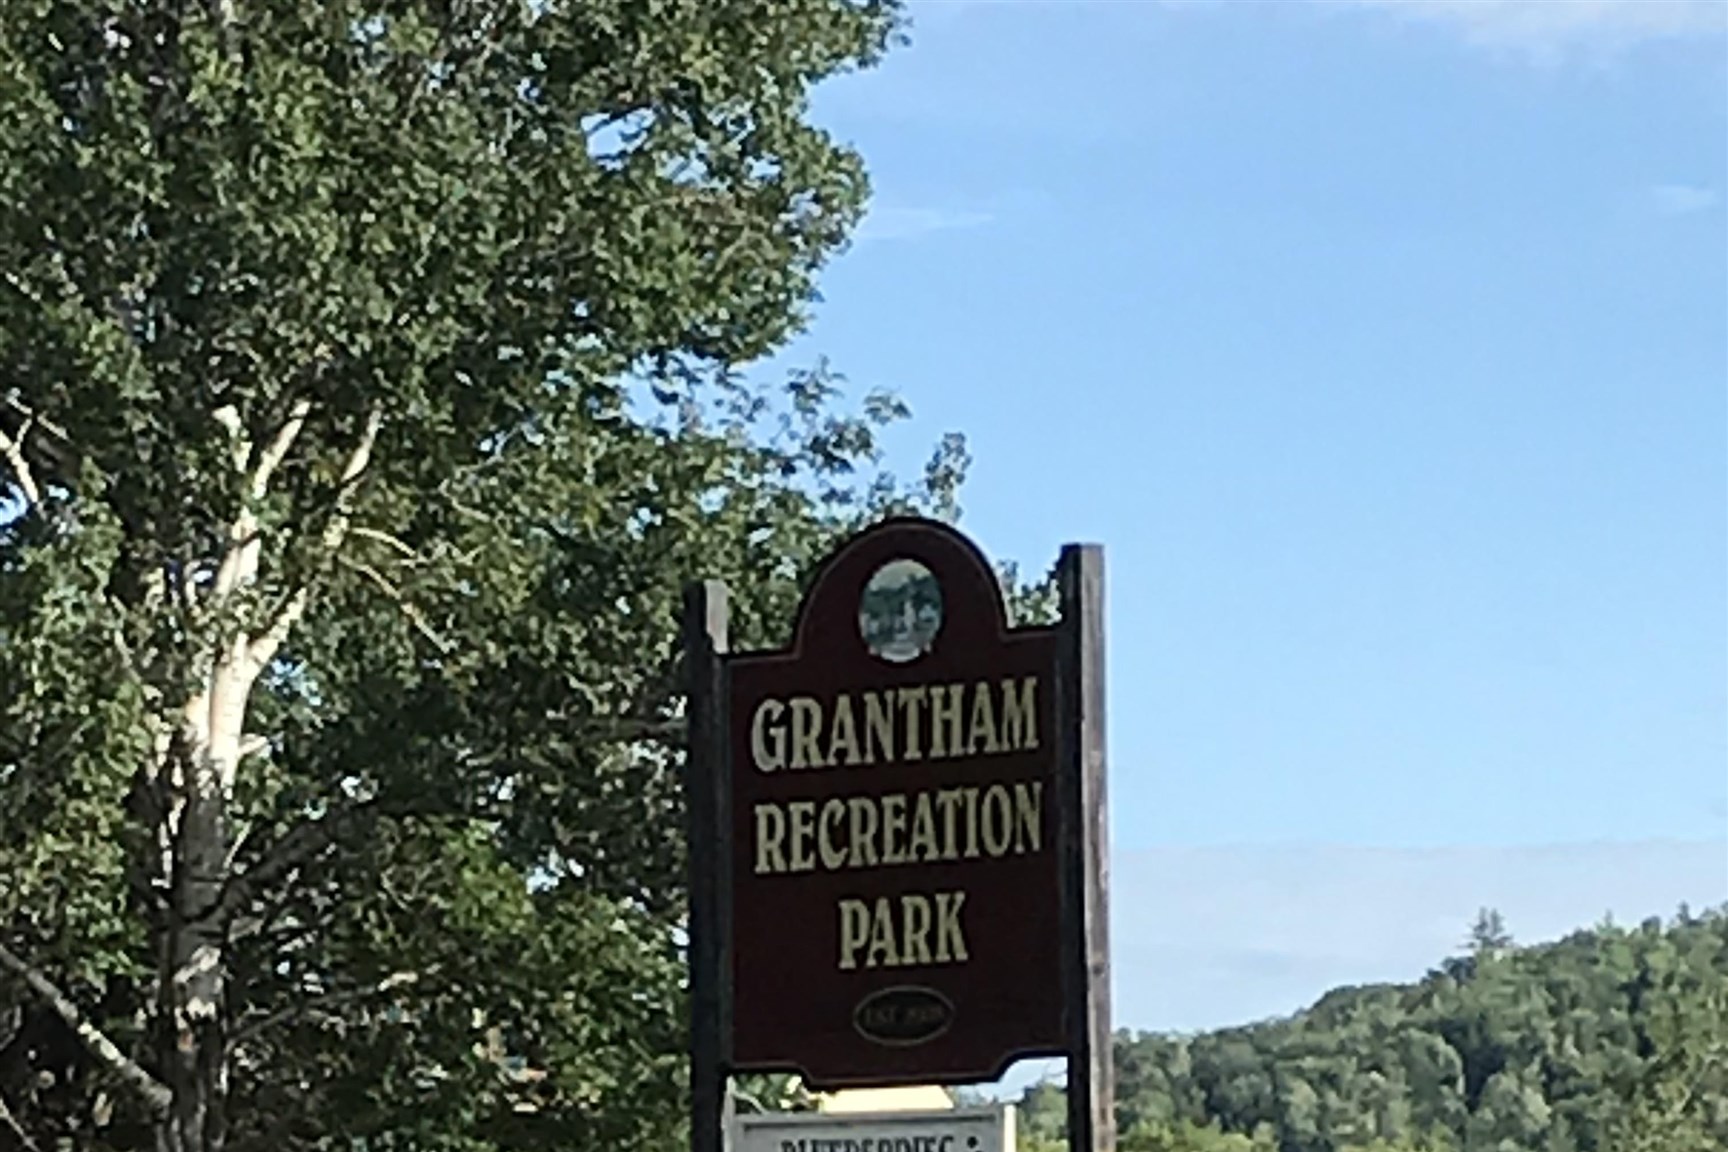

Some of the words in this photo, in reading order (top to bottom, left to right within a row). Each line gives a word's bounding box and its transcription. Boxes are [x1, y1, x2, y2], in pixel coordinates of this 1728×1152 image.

[751, 676, 1040, 772] GRANTHAM
[754, 781, 1042, 874] RECREATION
[838, 891, 968, 969] PARK
